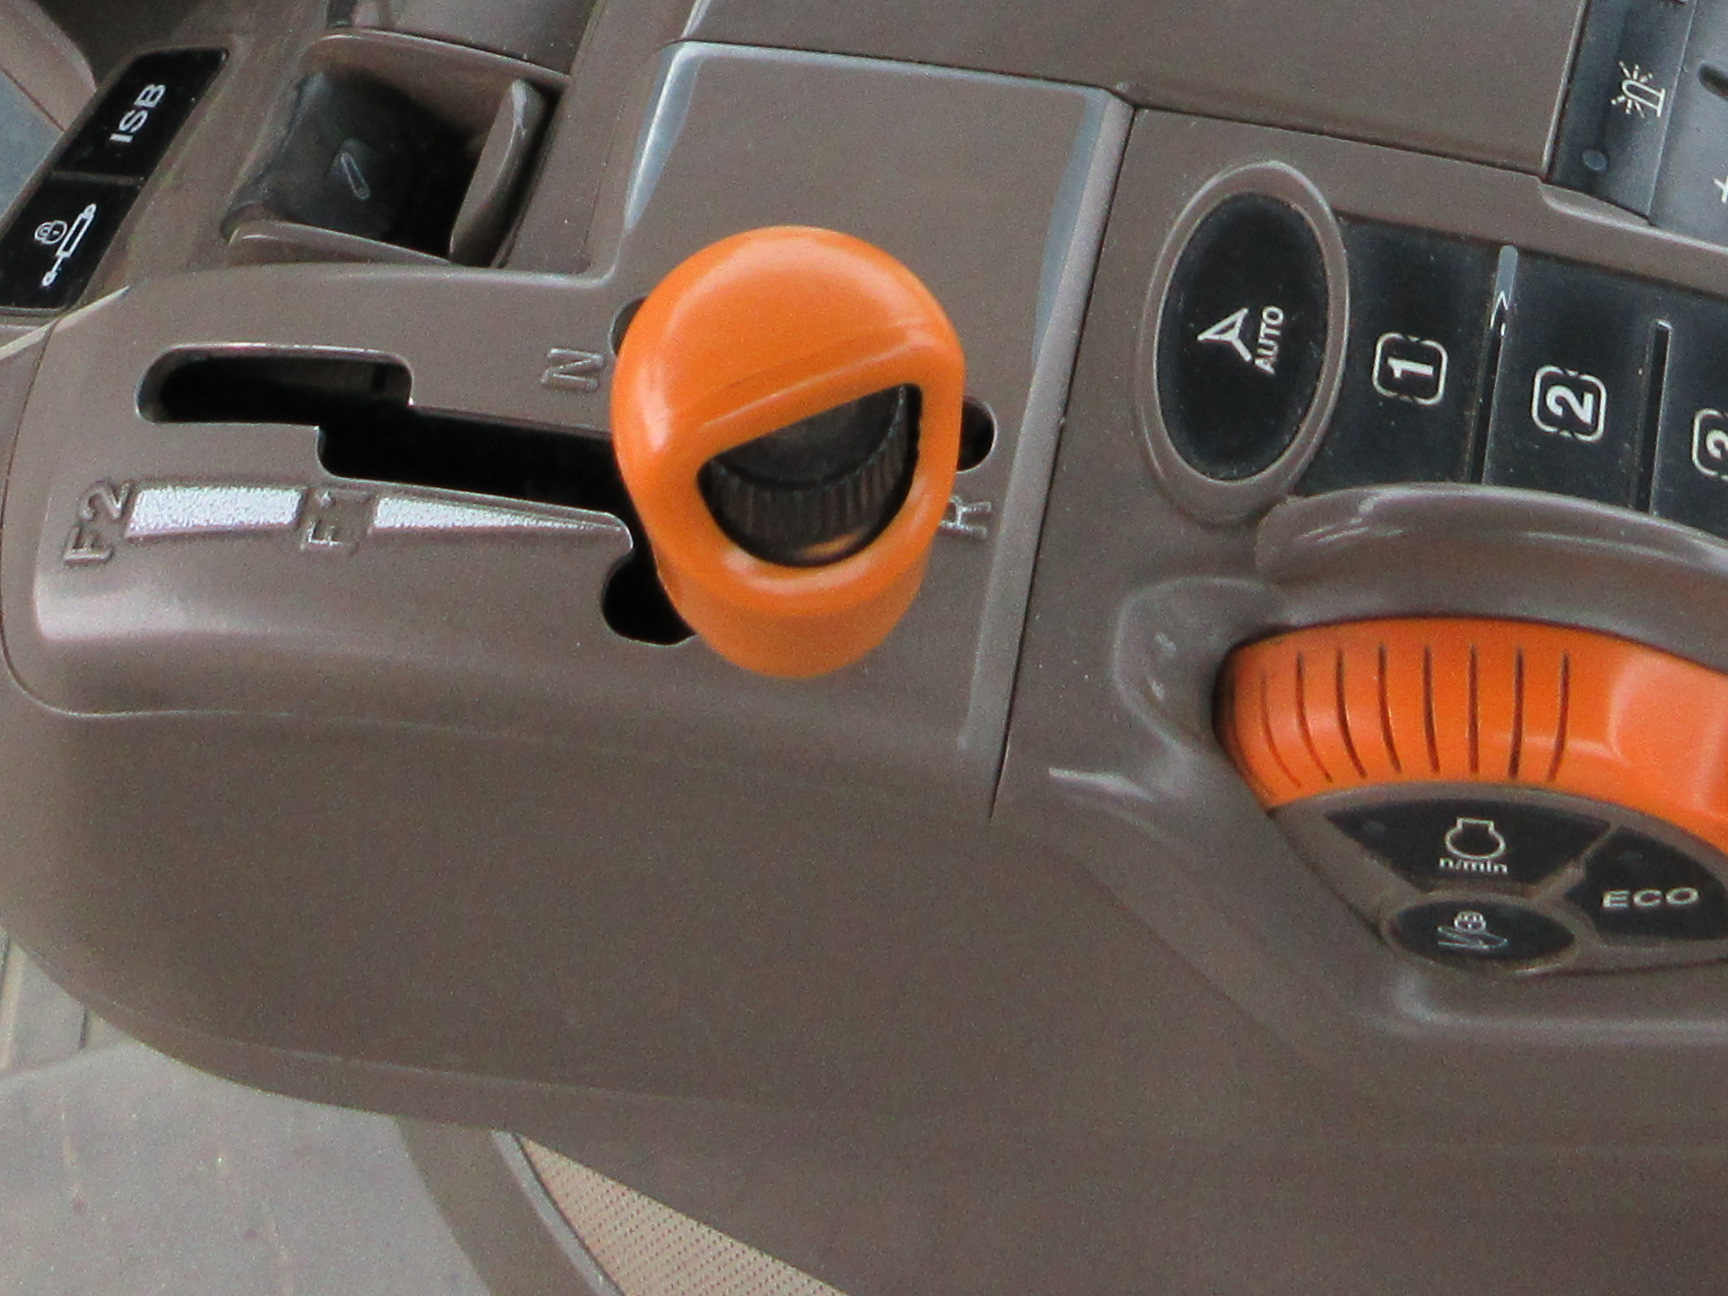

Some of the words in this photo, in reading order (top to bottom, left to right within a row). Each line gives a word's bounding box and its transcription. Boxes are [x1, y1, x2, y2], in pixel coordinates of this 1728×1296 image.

[108, 81, 166, 144] ISB
[1254, 305, 1285, 375] AUTO
[540, 347, 605, 392] N
[1387, 357, 1434, 379] 1
[1545, 383, 1595, 426] 2
[1601, 886, 1700, 909] ECO
